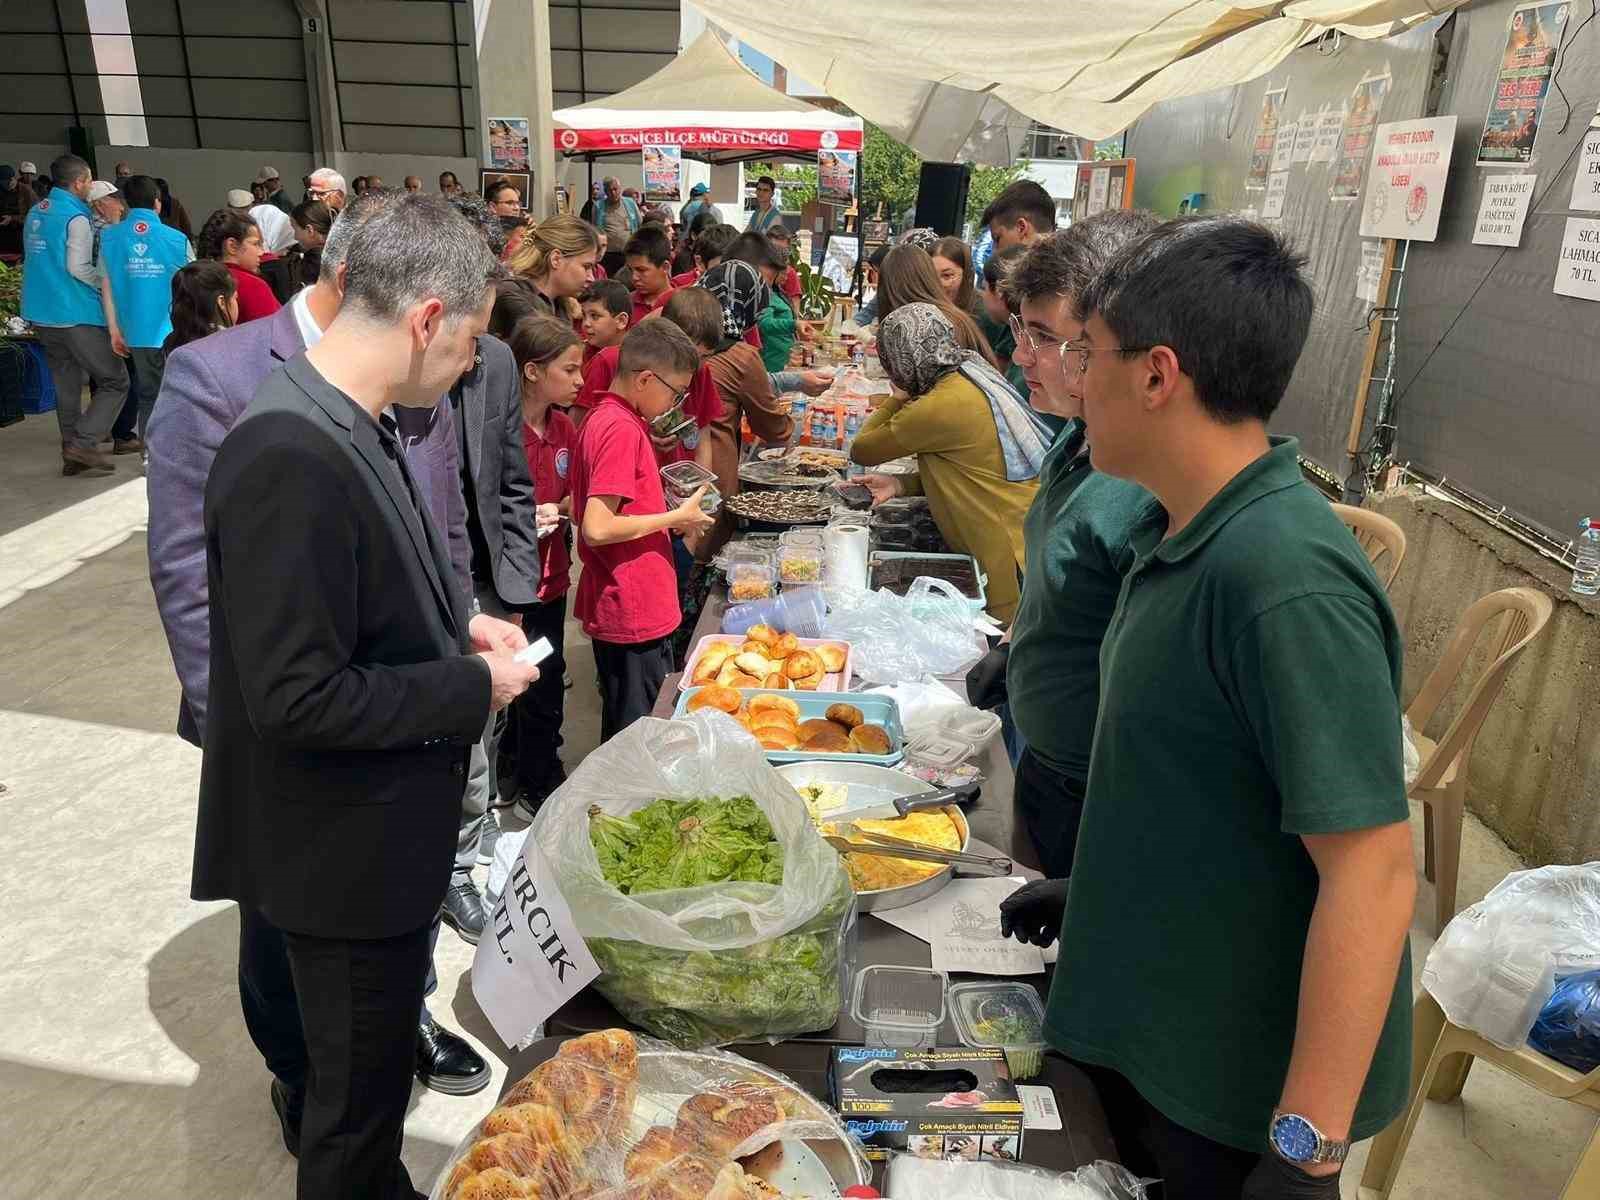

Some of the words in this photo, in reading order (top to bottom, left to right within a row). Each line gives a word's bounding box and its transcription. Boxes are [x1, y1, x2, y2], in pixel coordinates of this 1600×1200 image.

[308, 18, 317, 33] 9
[610, 131, 663, 144] YENİCE
[664, 130, 696, 146] İLÇE
[1583, 269, 1597, 282] TL.
[839, 1048, 897, 1061] Dolphin
[846, 1120, 909, 1135] Dolphin
[919, 1122, 933, 1131] Çok
[957, 1122, 977, 1132] Siyah
[977, 1122, 993, 1130] Nitril
[994, 1122, 1020, 1131] Eldiven
